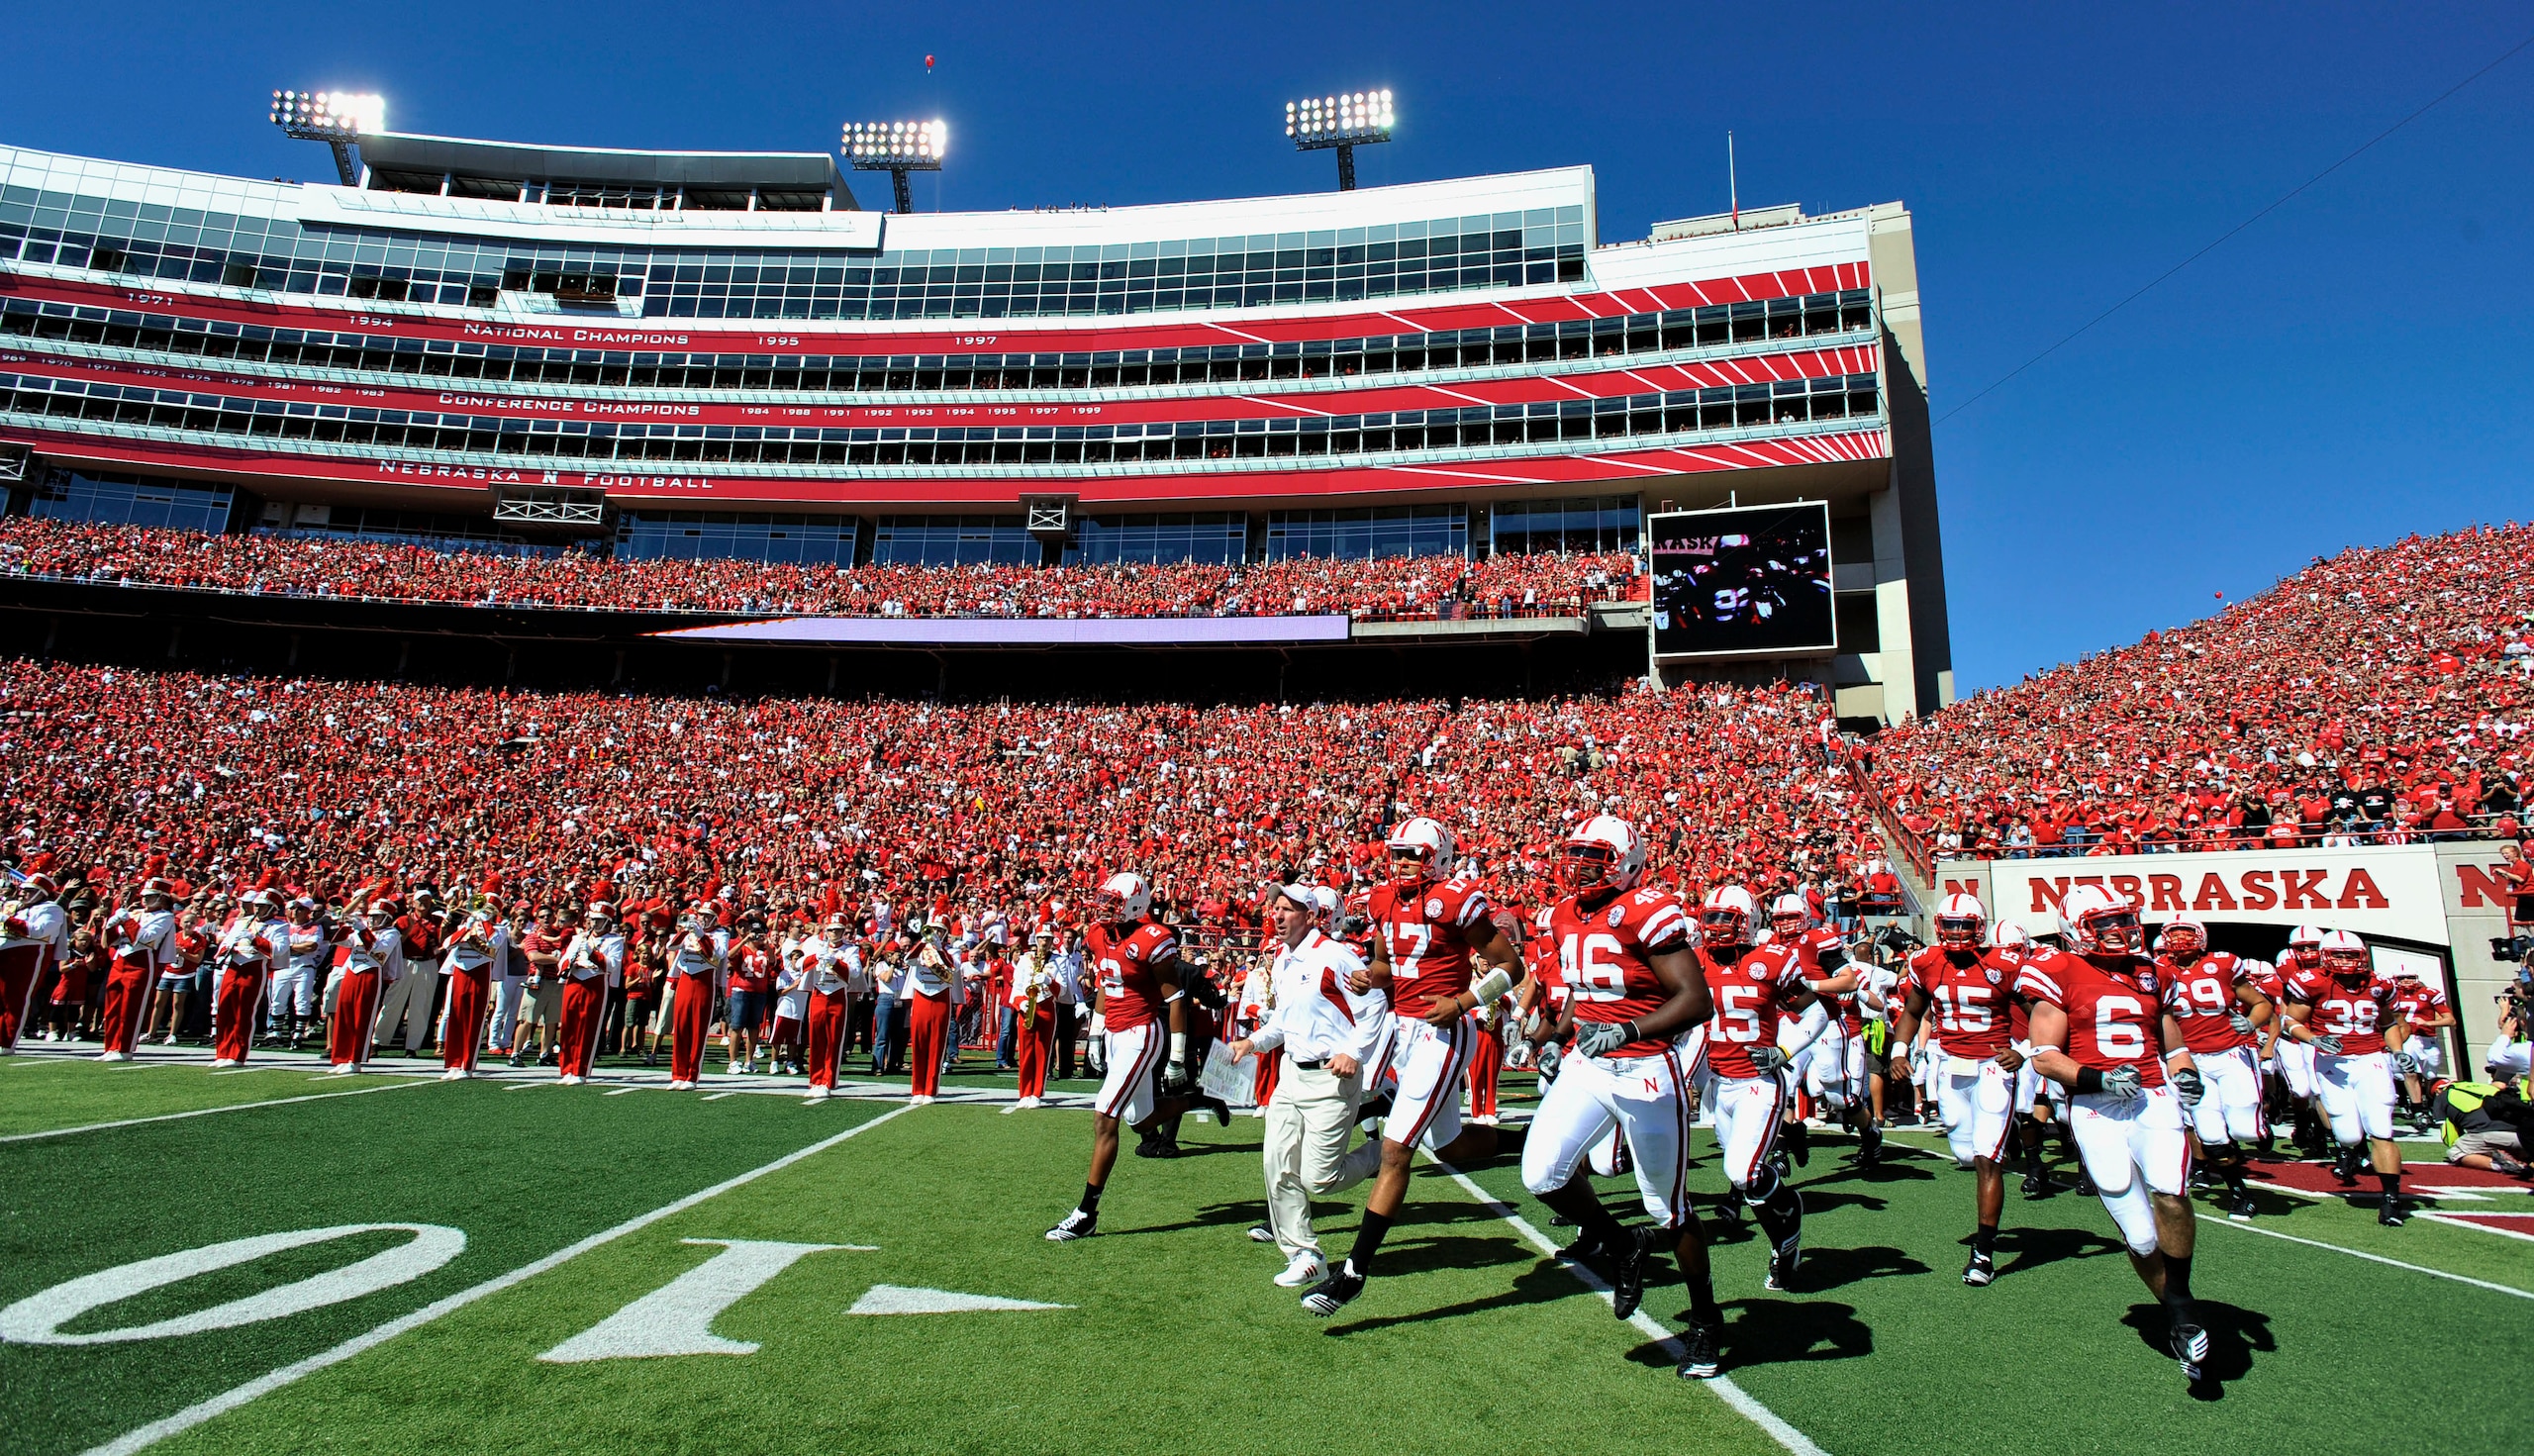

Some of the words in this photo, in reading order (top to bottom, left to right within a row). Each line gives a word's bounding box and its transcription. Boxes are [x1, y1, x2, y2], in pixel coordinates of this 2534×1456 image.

[128, 292, 174, 307] 1971
[349, 315, 393, 328] 1994
[463, 323, 564, 340] NATIONAL
[573, 330, 689, 345] CHAMPIONS
[758, 336, 800, 346] 1995
[954, 336, 998, 345] 1997
[42, 357, 73, 368] 1970
[87, 362, 117, 372] 1971
[137, 367, 167, 378] 1972
[225, 377, 254, 387] 1978
[268, 381, 297, 391] 1981
[311, 385, 341, 395] 1982
[355, 388, 385, 398] 1983
[439, 392, 574, 412] CONFERENCE
[583, 400, 701, 416] CHAMPIONS
[740, 407, 770, 416] 1984
[782, 407, 811, 417] 1988
[864, 408, 893, 417] 1992
[905, 408, 933, 417] 1993
[987, 407, 1017, 416] 1995
[1071, 406, 1102, 415] 1999
[379, 459, 521, 482] NEBRASKA
[541, 470, 558, 484] N
[584, 472, 714, 489] FOOTBALL
[2028, 867, 2389, 913] NBRASKA
[1383, 922, 1432, 980] 17
[1559, 932, 1628, 1004] 46
[1998, 949, 2021, 965] 15
[1709, 985, 1761, 1043] 15
[1932, 984, 1993, 1033] 15
[2173, 977, 2227, 1019] 69
[2321, 999, 2380, 1036] 38
[2095, 995, 2146, 1060] 6
[1644, 1077, 1659, 1094] N
[1750, 1086, 1759, 1096] N
